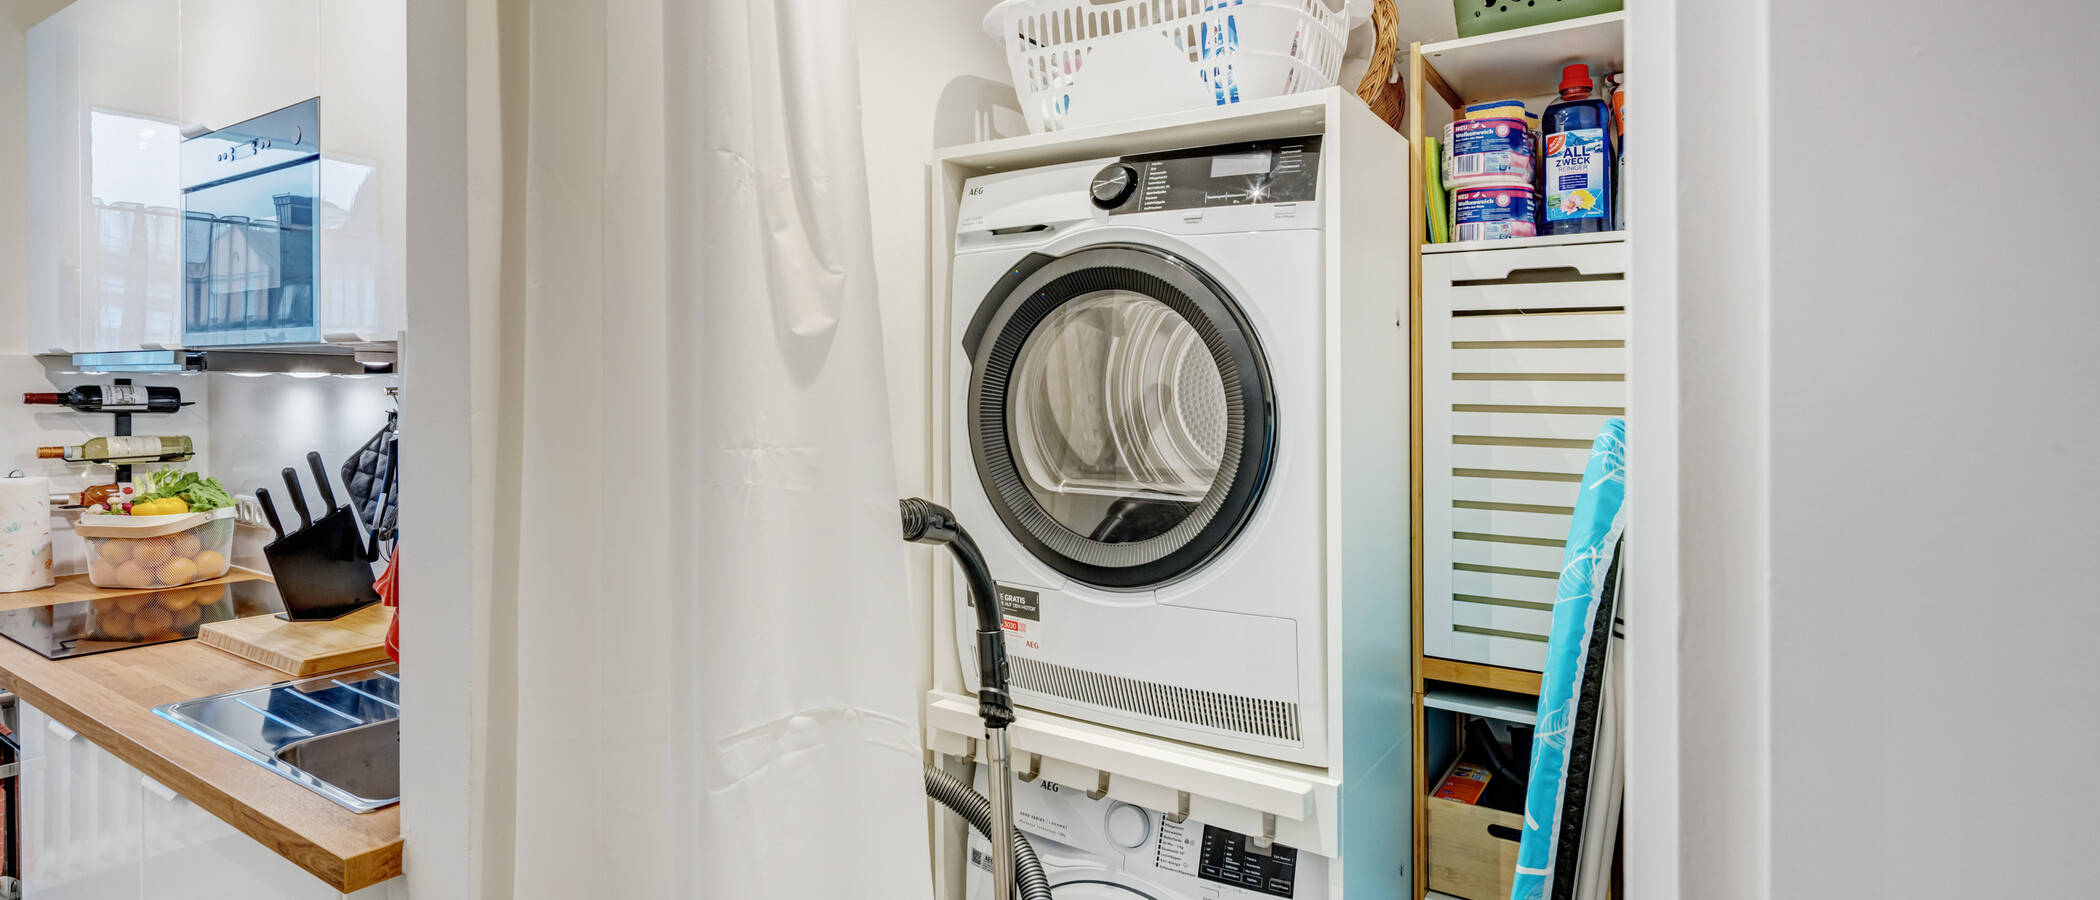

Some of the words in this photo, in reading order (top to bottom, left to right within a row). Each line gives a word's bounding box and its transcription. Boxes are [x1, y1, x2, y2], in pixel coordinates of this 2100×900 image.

[1455, 129, 1494, 138] Wolkenweich
[1563, 146, 1590, 158] ALL
[1556, 157, 1590, 167] ZWECK
[1558, 164, 1588, 172] REINIGER
[968, 186, 984, 196] AEG
[1004, 594, 1026, 605] GRATIS
[1026, 640, 1039, 649] AEG
[1040, 780, 1059, 793] AEG
